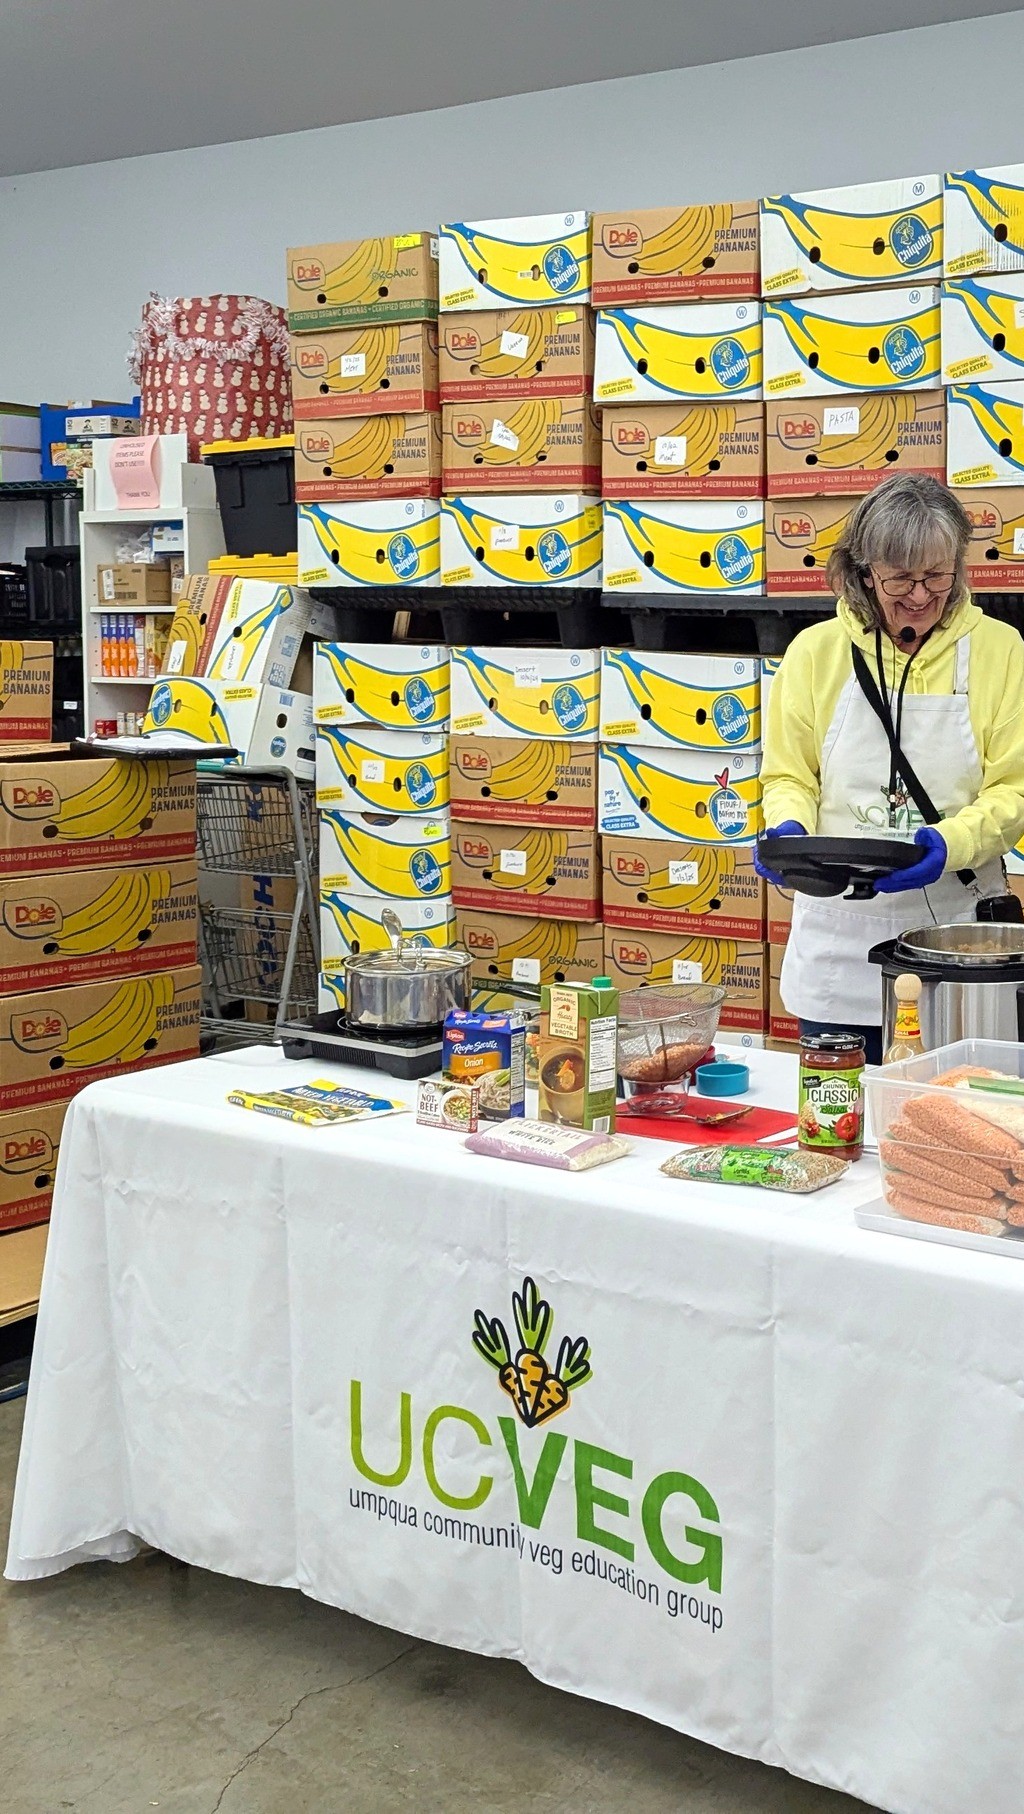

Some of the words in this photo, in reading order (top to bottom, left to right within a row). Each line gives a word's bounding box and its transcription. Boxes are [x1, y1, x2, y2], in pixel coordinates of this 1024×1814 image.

[609, 229, 639, 244] Dole
[715, 229, 757, 240] PREMIUM
[713, 241, 756, 252] BANANAS
[897, 230, 933, 264] Chiquita
[297, 265, 321, 279] Dole
[370, 267, 419, 281] ORGANIC
[544, 334, 580, 345] PREMIUM
[544, 346, 580, 357] BANANAS
[829, 411, 854, 425] PASTA
[618, 427, 645, 442] Dole
[719, 432, 759, 443] PREMIUM
[719, 445, 759, 455] BANANAS
[719, 712, 748, 737] Chiquita
[13, 786, 53, 804] Dole
[151, 786, 195, 799] PREMIUM
[150, 799, 195, 812] BANANAS
[554, 856, 589, 868] PREMIUM
[617, 858, 645, 871] Dole
[553, 868, 588, 880] BANANAS
[719, 874, 758, 887] PREMIUM
[719, 886, 758, 899] BANANAS
[15, 905, 55, 925] Dole
[548, 955, 598, 970] ORGANIC
[553, 997, 576, 1006] ORGANIC
[551, 1022, 577, 1031] VEGETABLE
[554, 1029, 574, 1037] BROTH
[464, 1057, 484, 1067] Onion
[810, 1089, 858, 1104] CLASSIC
[420, 1102, 438, 1112] BEEF
[350, 1379, 723, 1595] UCVEG
[349, 1487, 418, 1528] umpqua
[529, 1539, 563, 1574] veg
[572, 1549, 659, 1606] education
[667, 1588, 724, 1633] group
